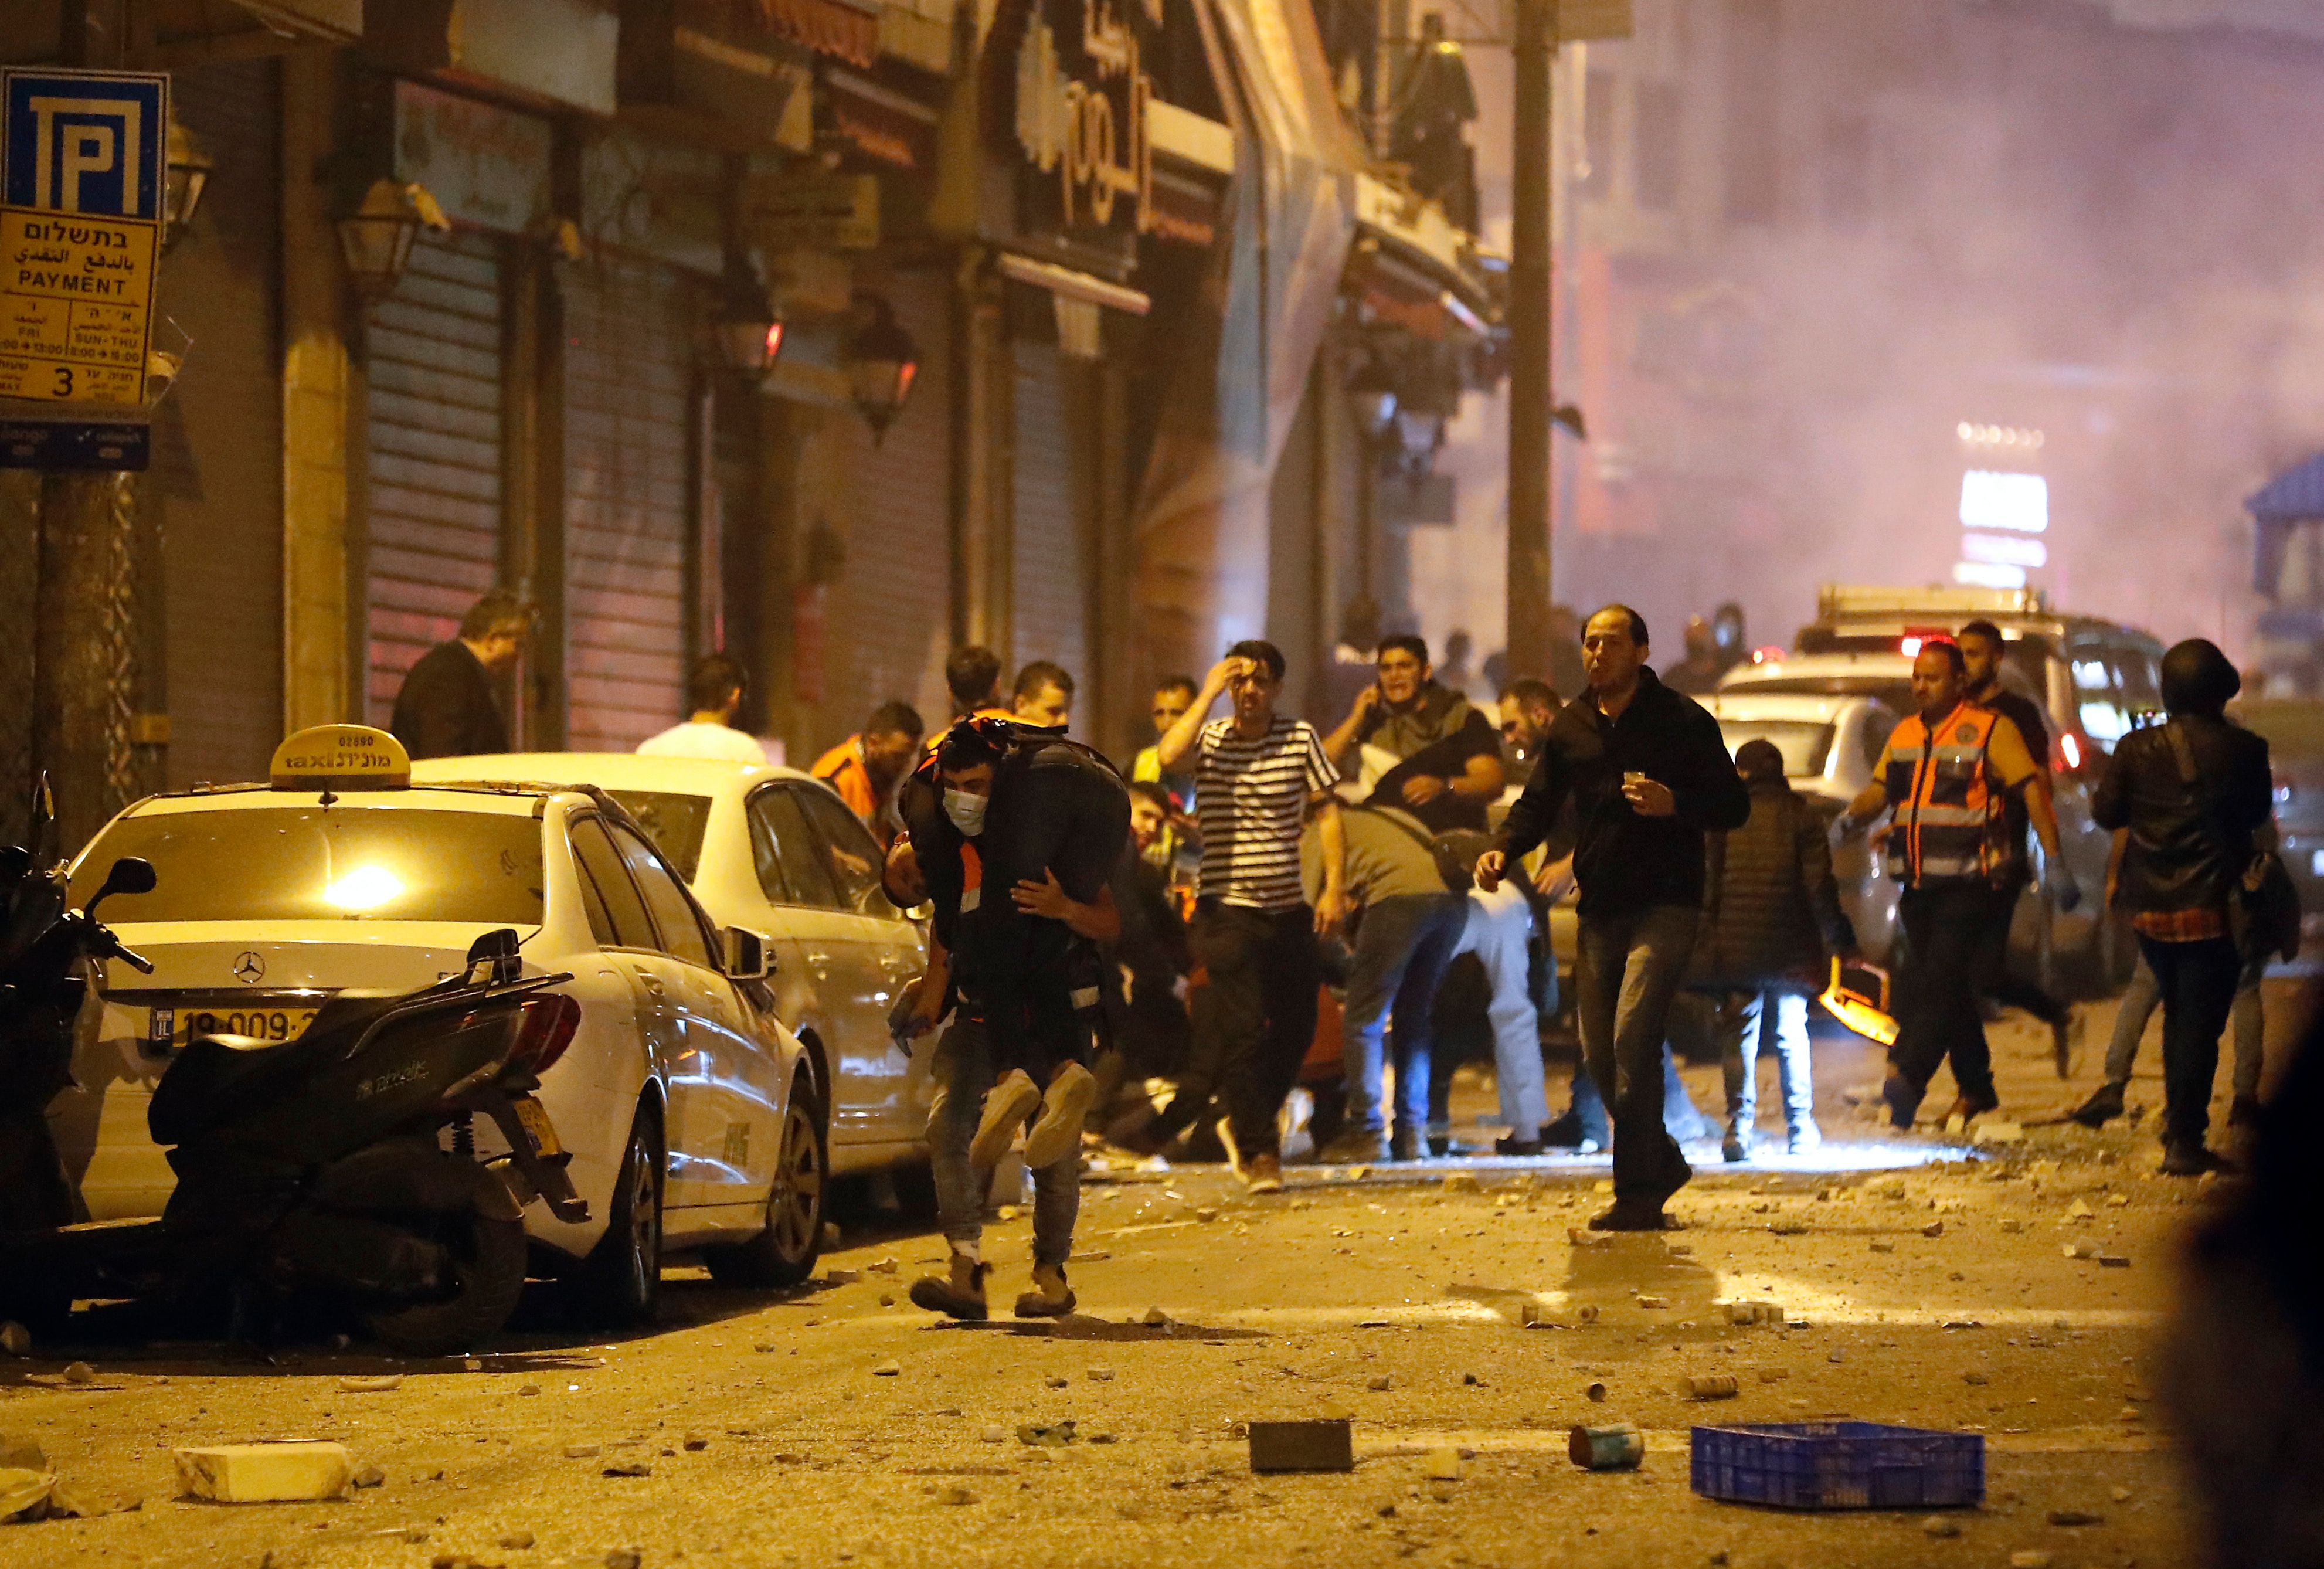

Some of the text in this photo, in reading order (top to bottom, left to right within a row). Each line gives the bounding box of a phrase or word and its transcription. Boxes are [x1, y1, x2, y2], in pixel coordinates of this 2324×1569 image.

[24, 221, 128, 248] בתשלום
[19, 270, 125, 294] PAYMENT
[52, 368, 73, 396] 3
